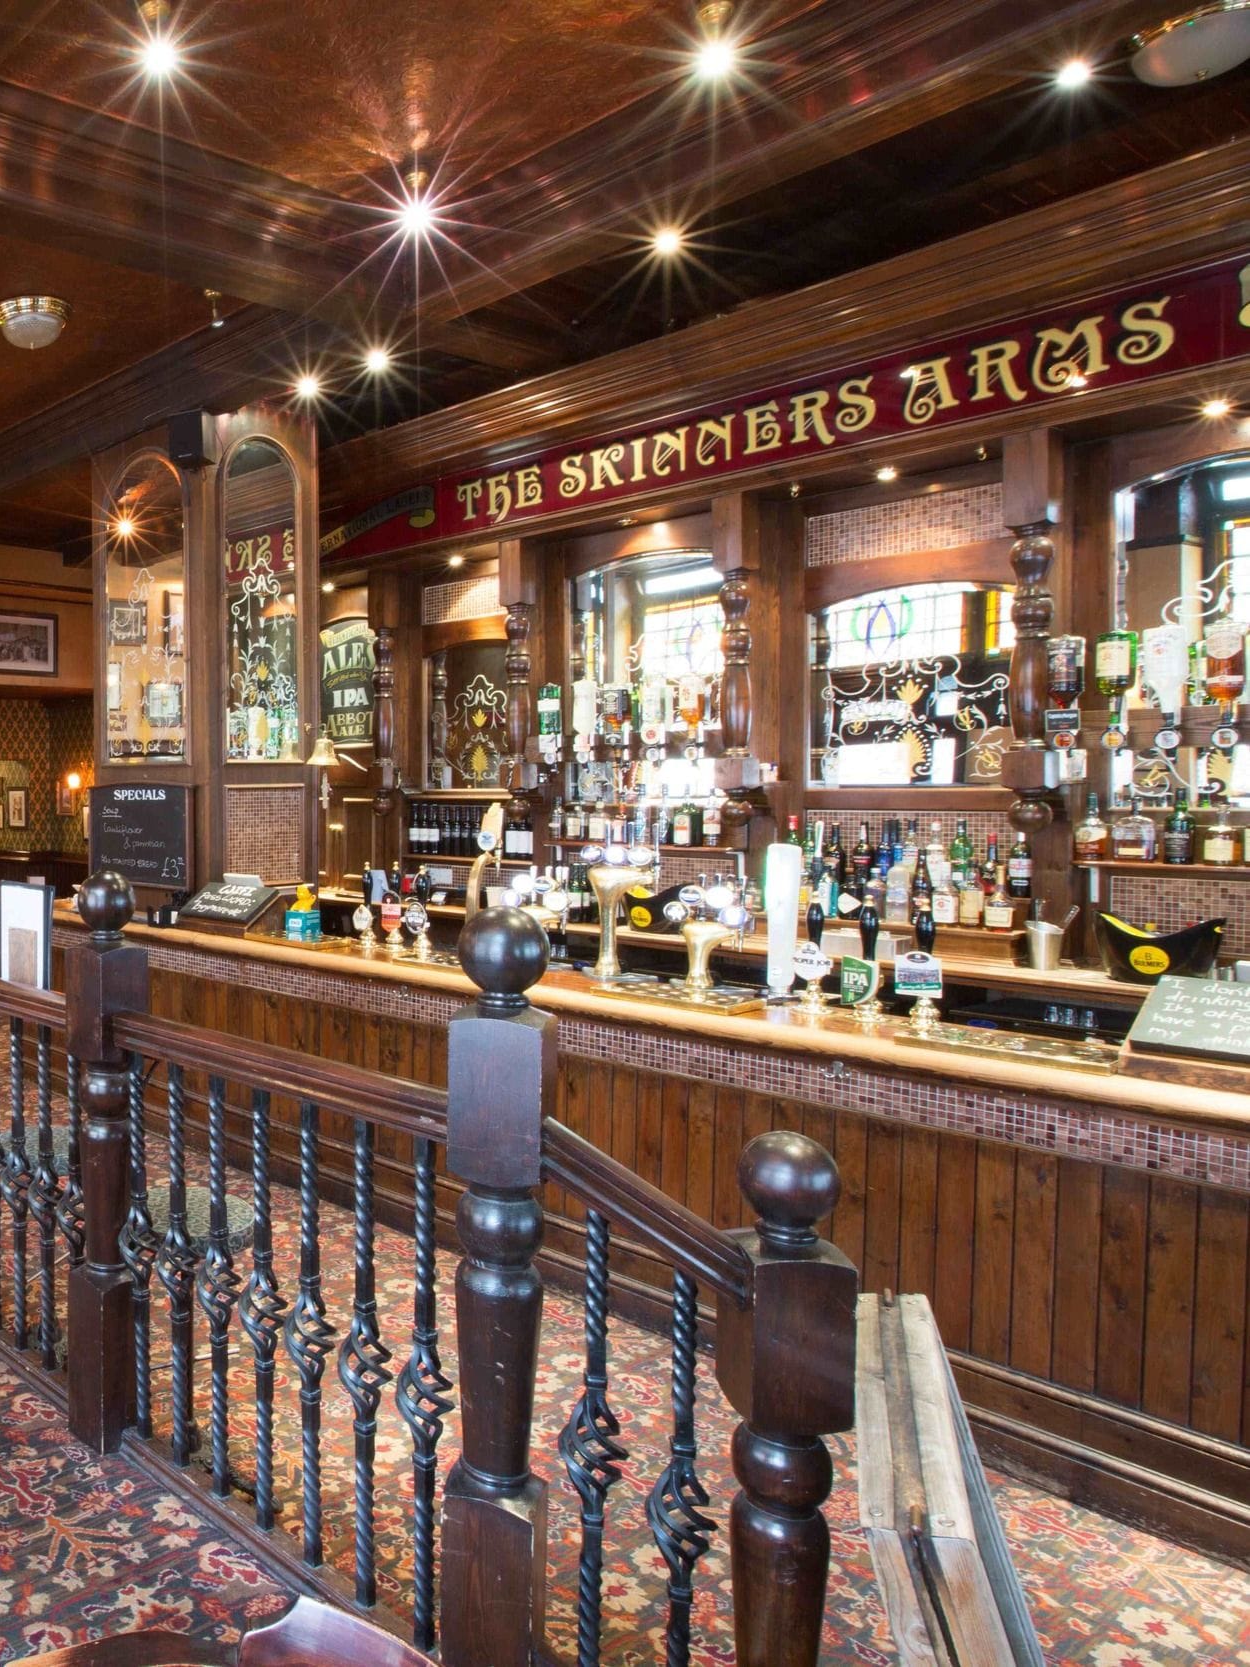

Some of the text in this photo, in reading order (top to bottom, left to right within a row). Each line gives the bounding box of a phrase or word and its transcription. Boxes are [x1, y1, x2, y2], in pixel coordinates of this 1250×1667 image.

[456, 295, 1175, 523] THE SKINNERS ARMS
[332, 686, 370, 709] IPA
[338, 724, 365, 737] ALE
[113, 789, 166, 801] SPECIALS
[843, 971, 869, 988] IPA
[1152, 1012, 1196, 1028] have
[1148, 1026, 1182, 1040] my
